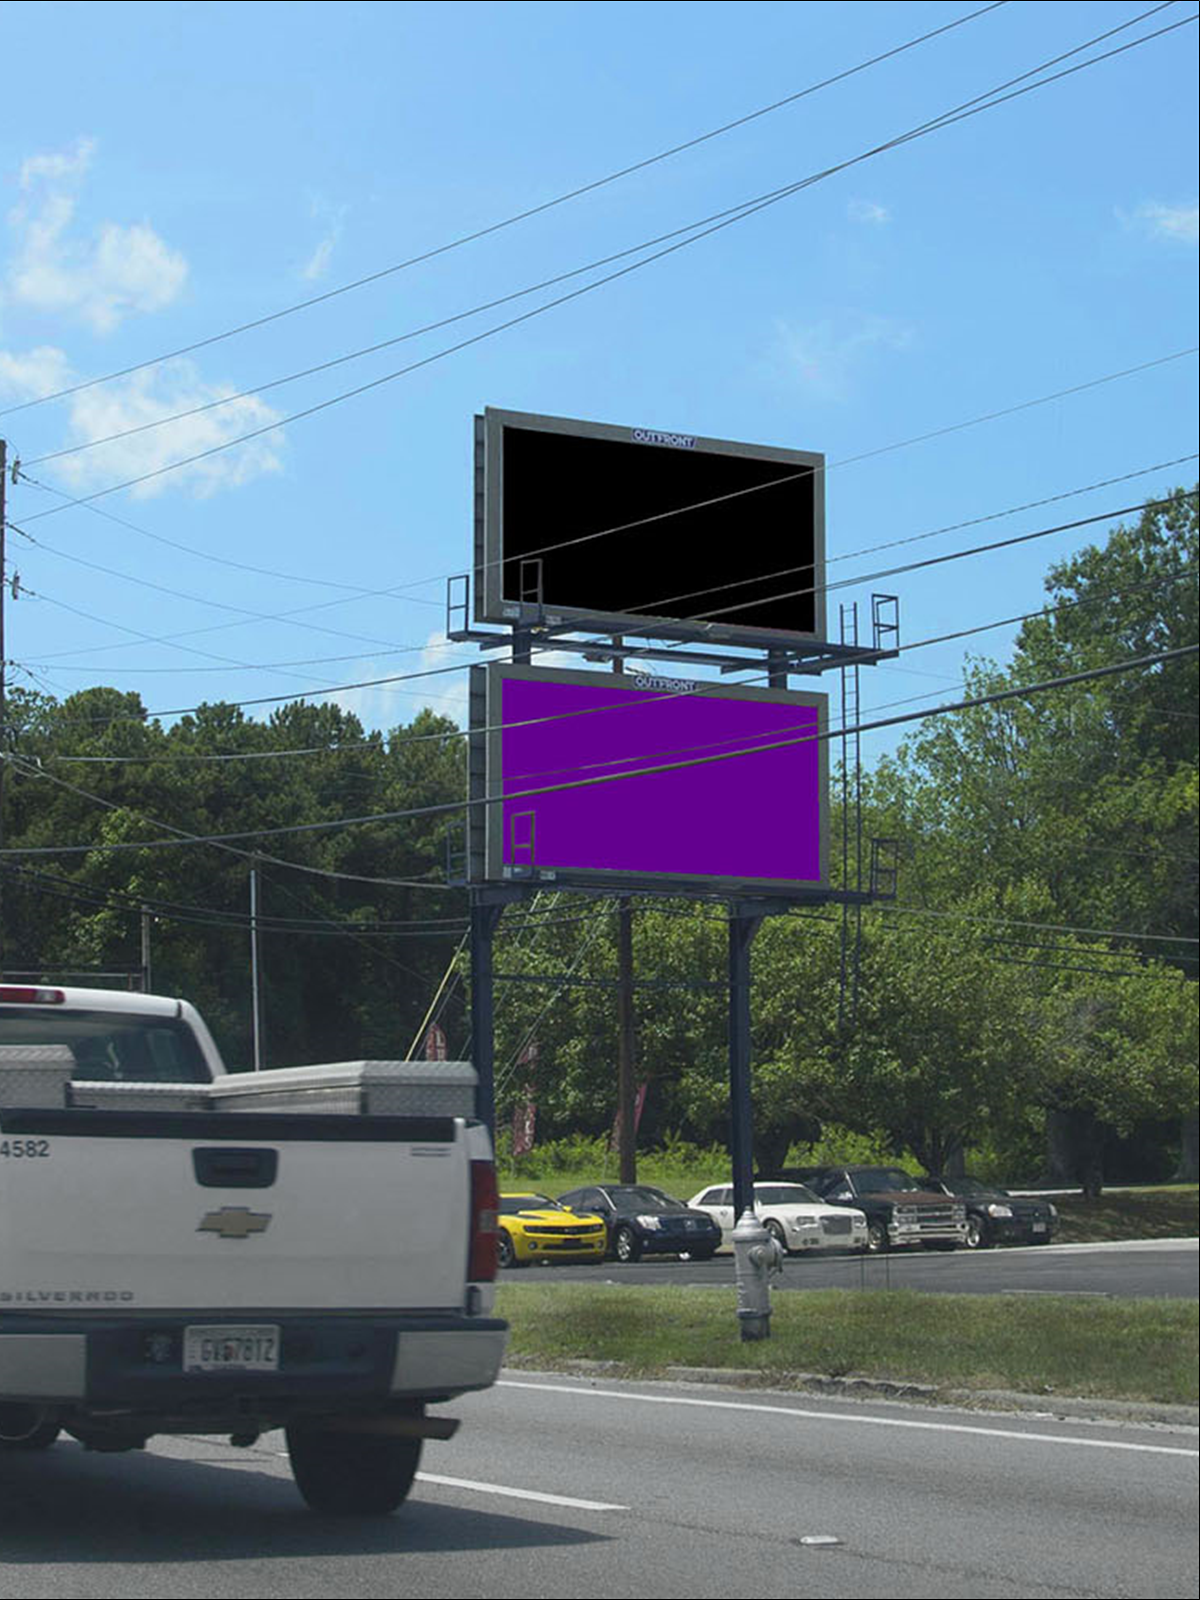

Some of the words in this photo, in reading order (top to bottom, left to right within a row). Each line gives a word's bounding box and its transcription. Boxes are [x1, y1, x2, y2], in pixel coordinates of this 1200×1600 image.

[633, 429, 695, 448] OUTFRONT
[635, 675, 695, 692] OUTFRONT
[0, 1139, 50, 1158] 4582
